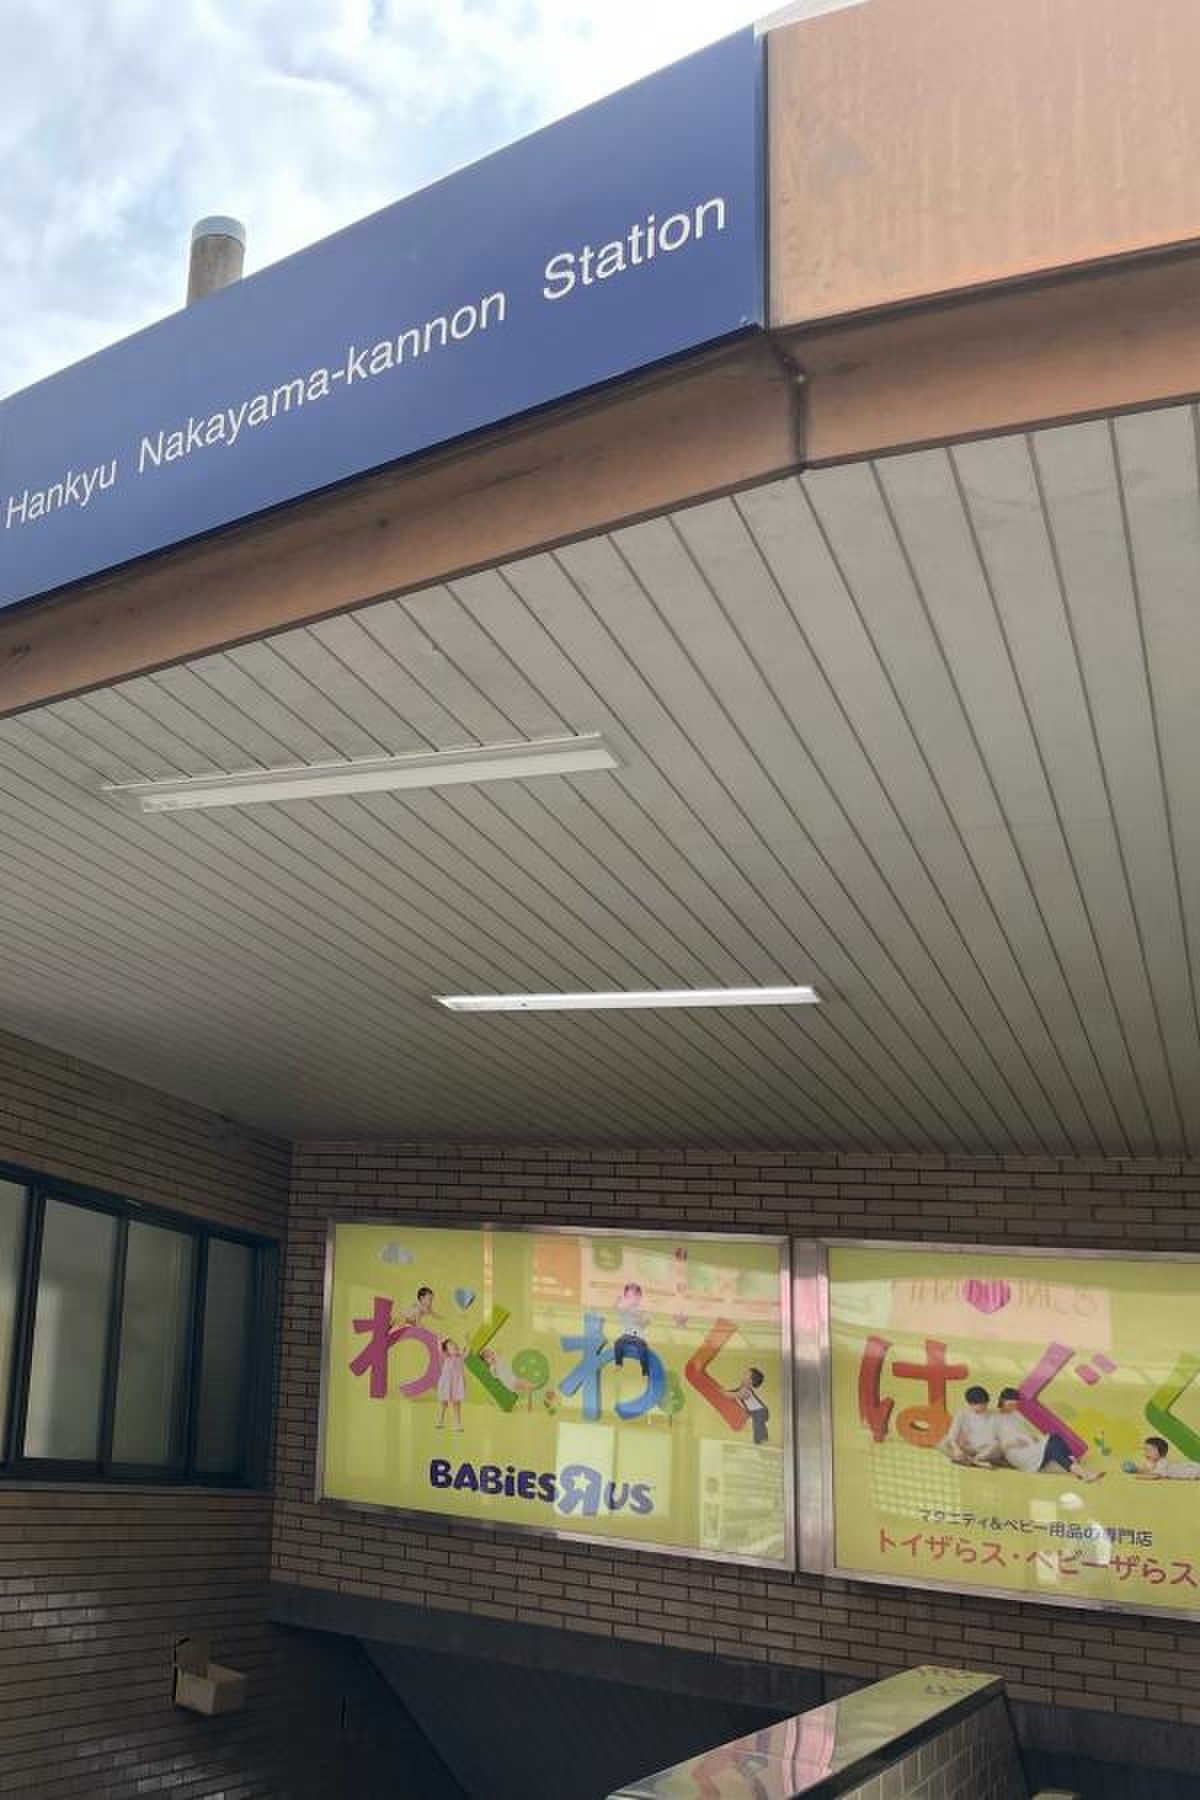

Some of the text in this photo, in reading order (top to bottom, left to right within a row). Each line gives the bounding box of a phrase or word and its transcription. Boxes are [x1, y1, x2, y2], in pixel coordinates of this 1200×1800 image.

[5, 196, 727, 529] Hankyu Nakayama-kannon Station
[348, 1295, 752, 1434] わくわく
